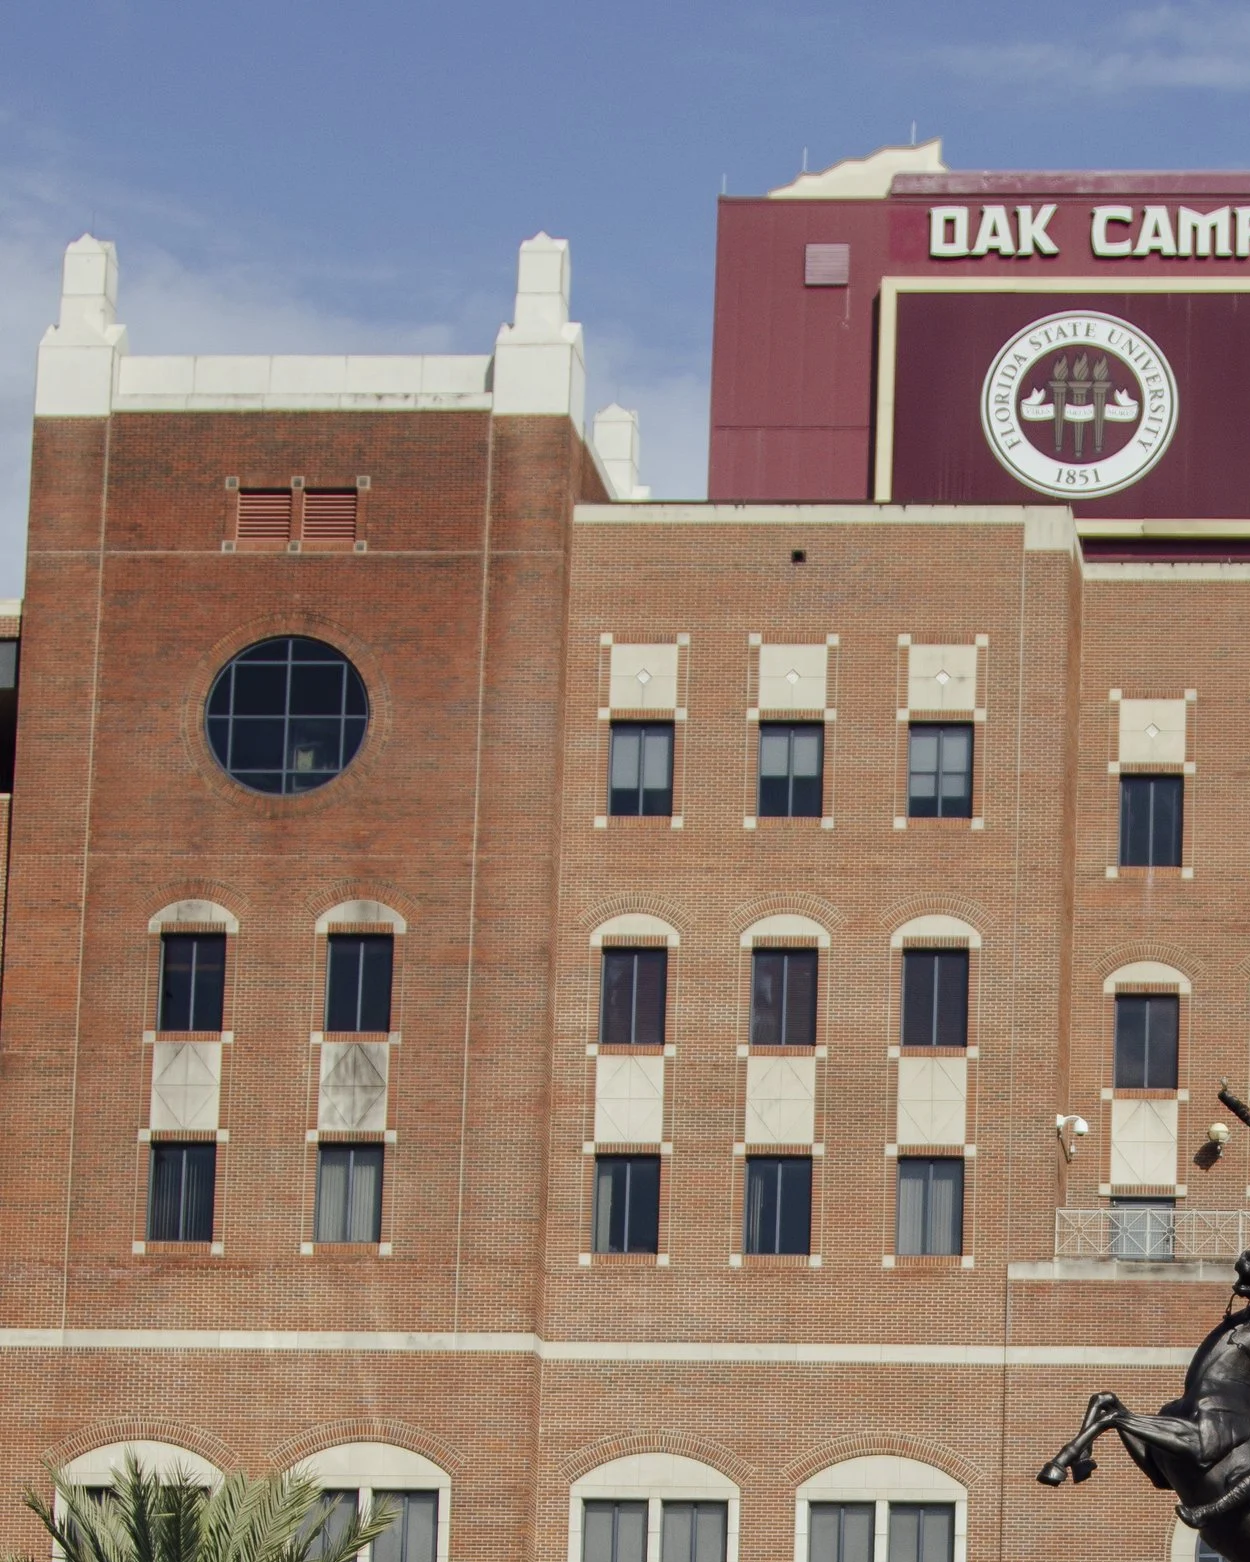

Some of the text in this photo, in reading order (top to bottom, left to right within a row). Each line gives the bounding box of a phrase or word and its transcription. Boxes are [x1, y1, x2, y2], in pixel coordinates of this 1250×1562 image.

[928, 204, 1059, 257] OAK
[994, 322, 1166, 452] FLORIDA STATE UNIVERSITY
[1055, 467, 1102, 485] 1851
